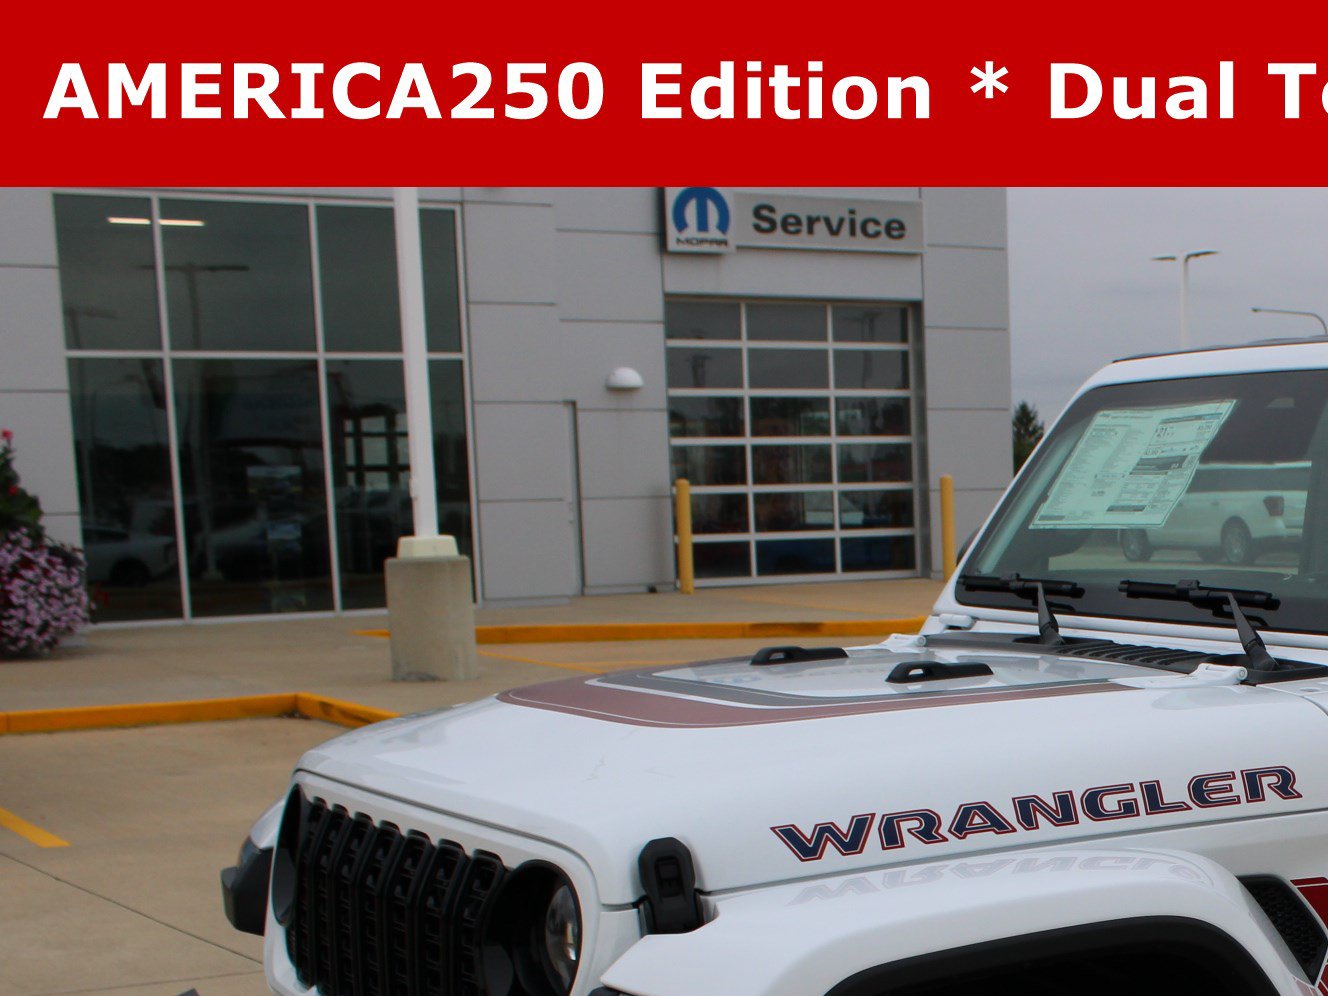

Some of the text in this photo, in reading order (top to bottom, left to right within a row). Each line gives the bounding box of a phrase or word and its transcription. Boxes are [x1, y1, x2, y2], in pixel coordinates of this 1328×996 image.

[752, 203, 906, 240] Service
[676, 236, 729, 247] MOPAR
[770, 766, 1303, 862] WRANGLER
